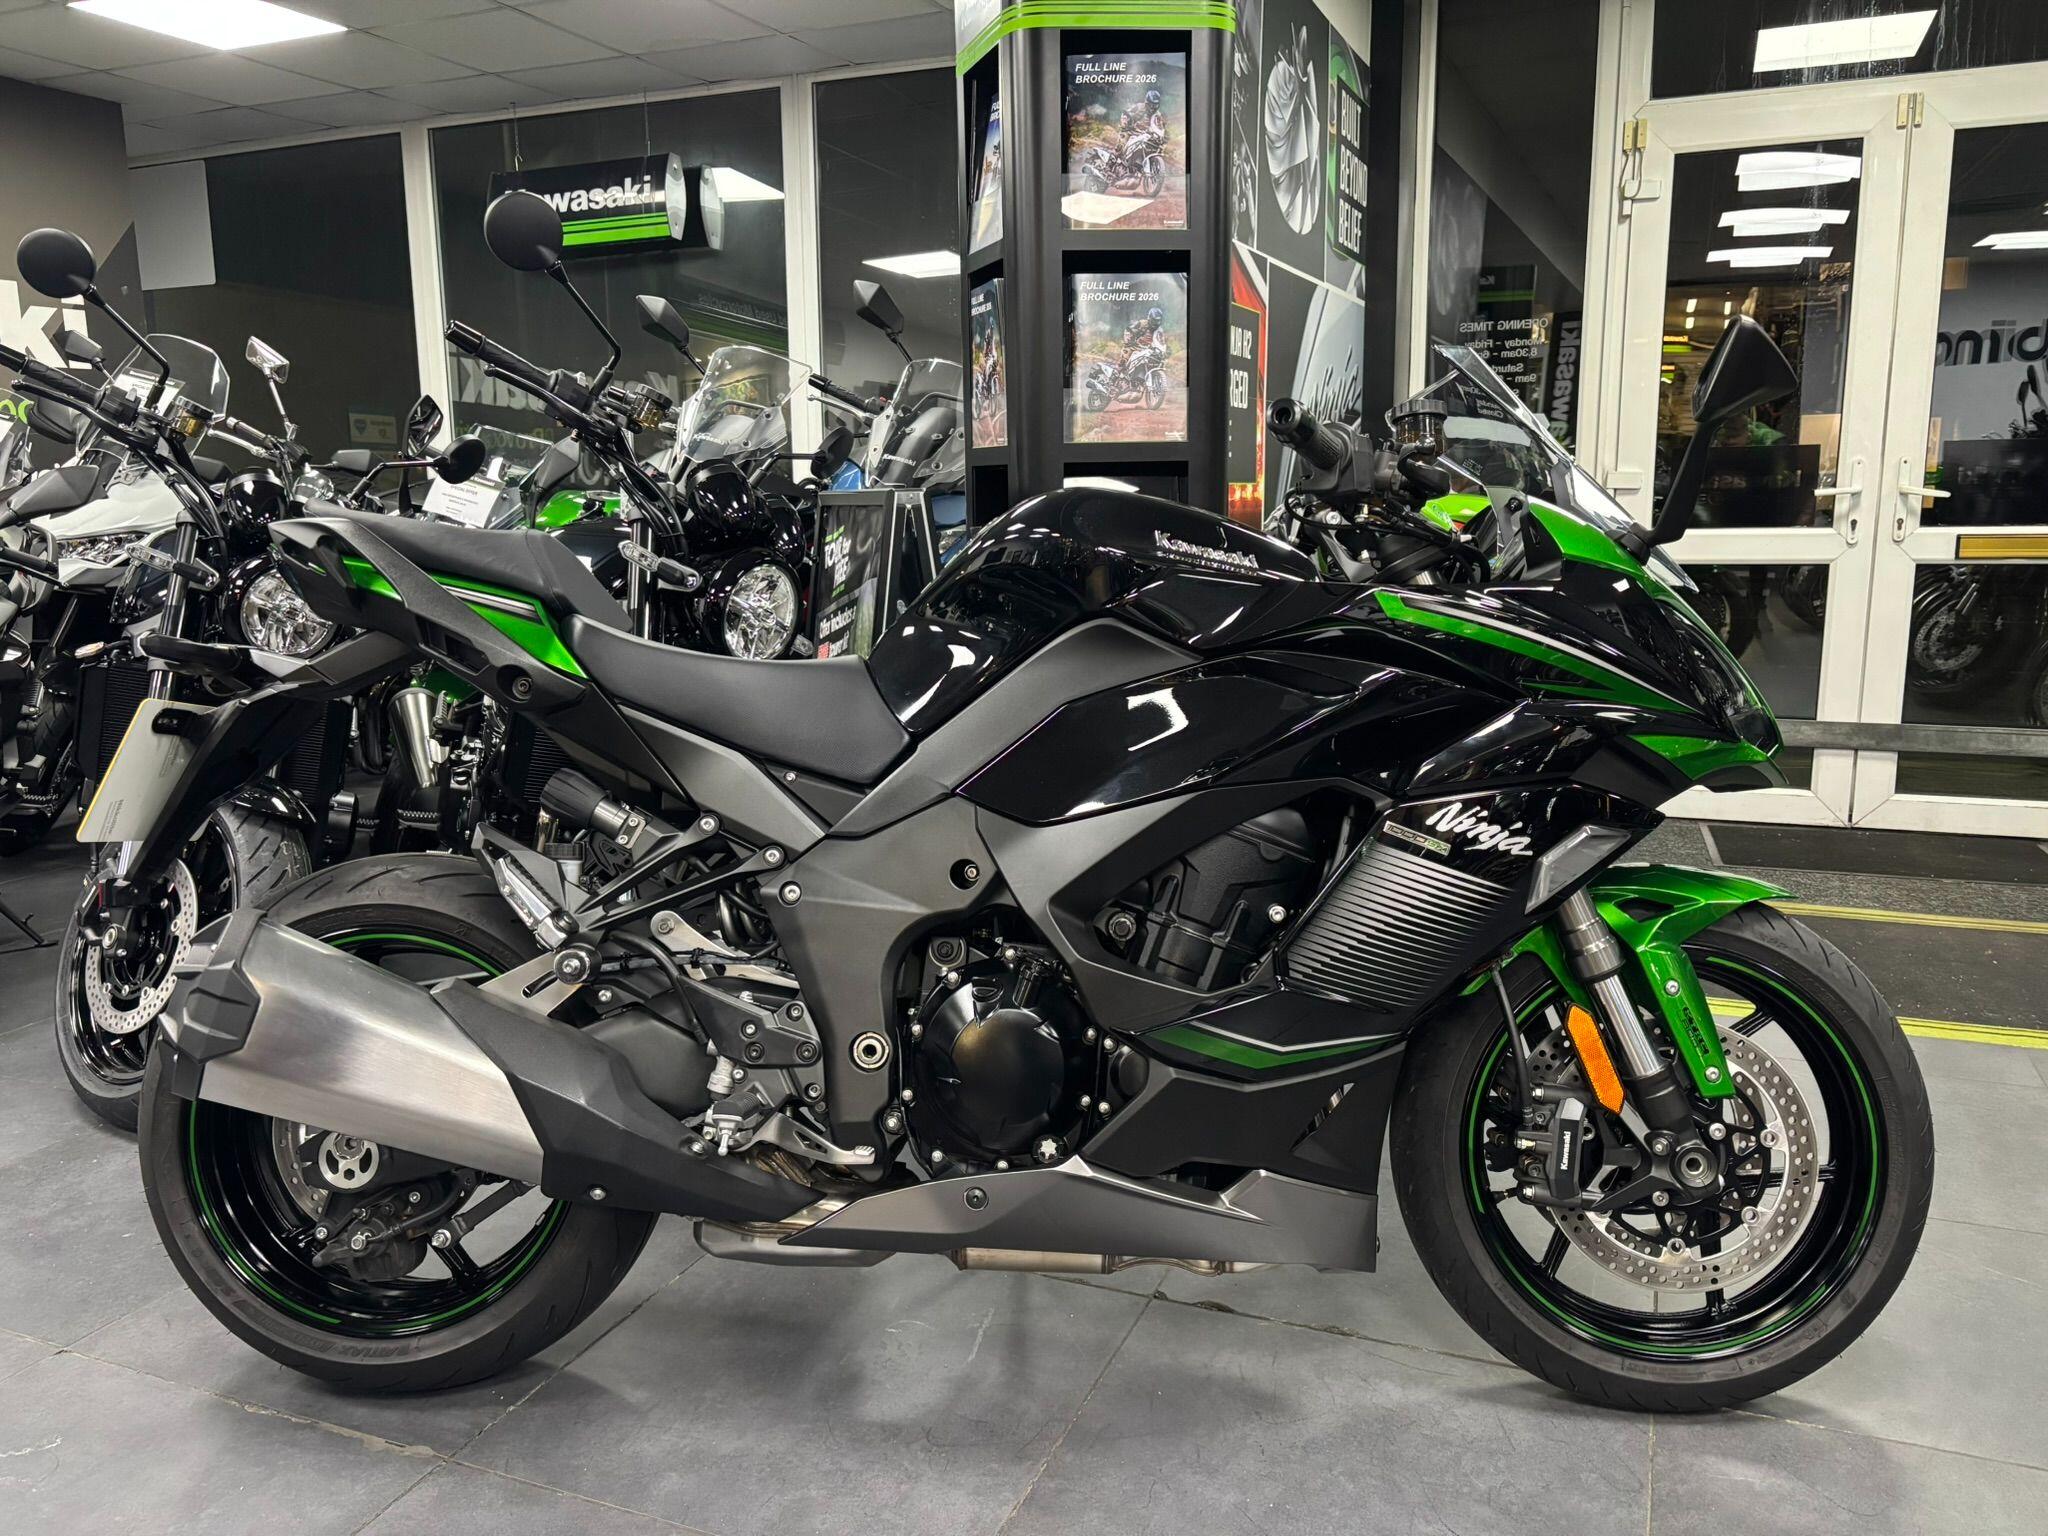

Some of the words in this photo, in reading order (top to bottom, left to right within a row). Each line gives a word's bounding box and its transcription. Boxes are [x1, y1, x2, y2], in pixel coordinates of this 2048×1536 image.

[1075, 62, 1101, 72] FULL
[1103, 62, 1127, 71] LINE
[1075, 74, 1133, 84] BROCHURE
[1135, 74, 1157, 83] 2026
[1081, 281, 1105, 290] FULL
[1107, 281, 1130, 290] LINE
[1080, 292, 1136, 301] BROCHURE
[1138, 292, 1159, 301] 2026
[1154, 529, 1260, 569] Kawasaki
[1425, 802, 1533, 856] Ninja
[1560, 1130, 1572, 1170] Kawasaki
